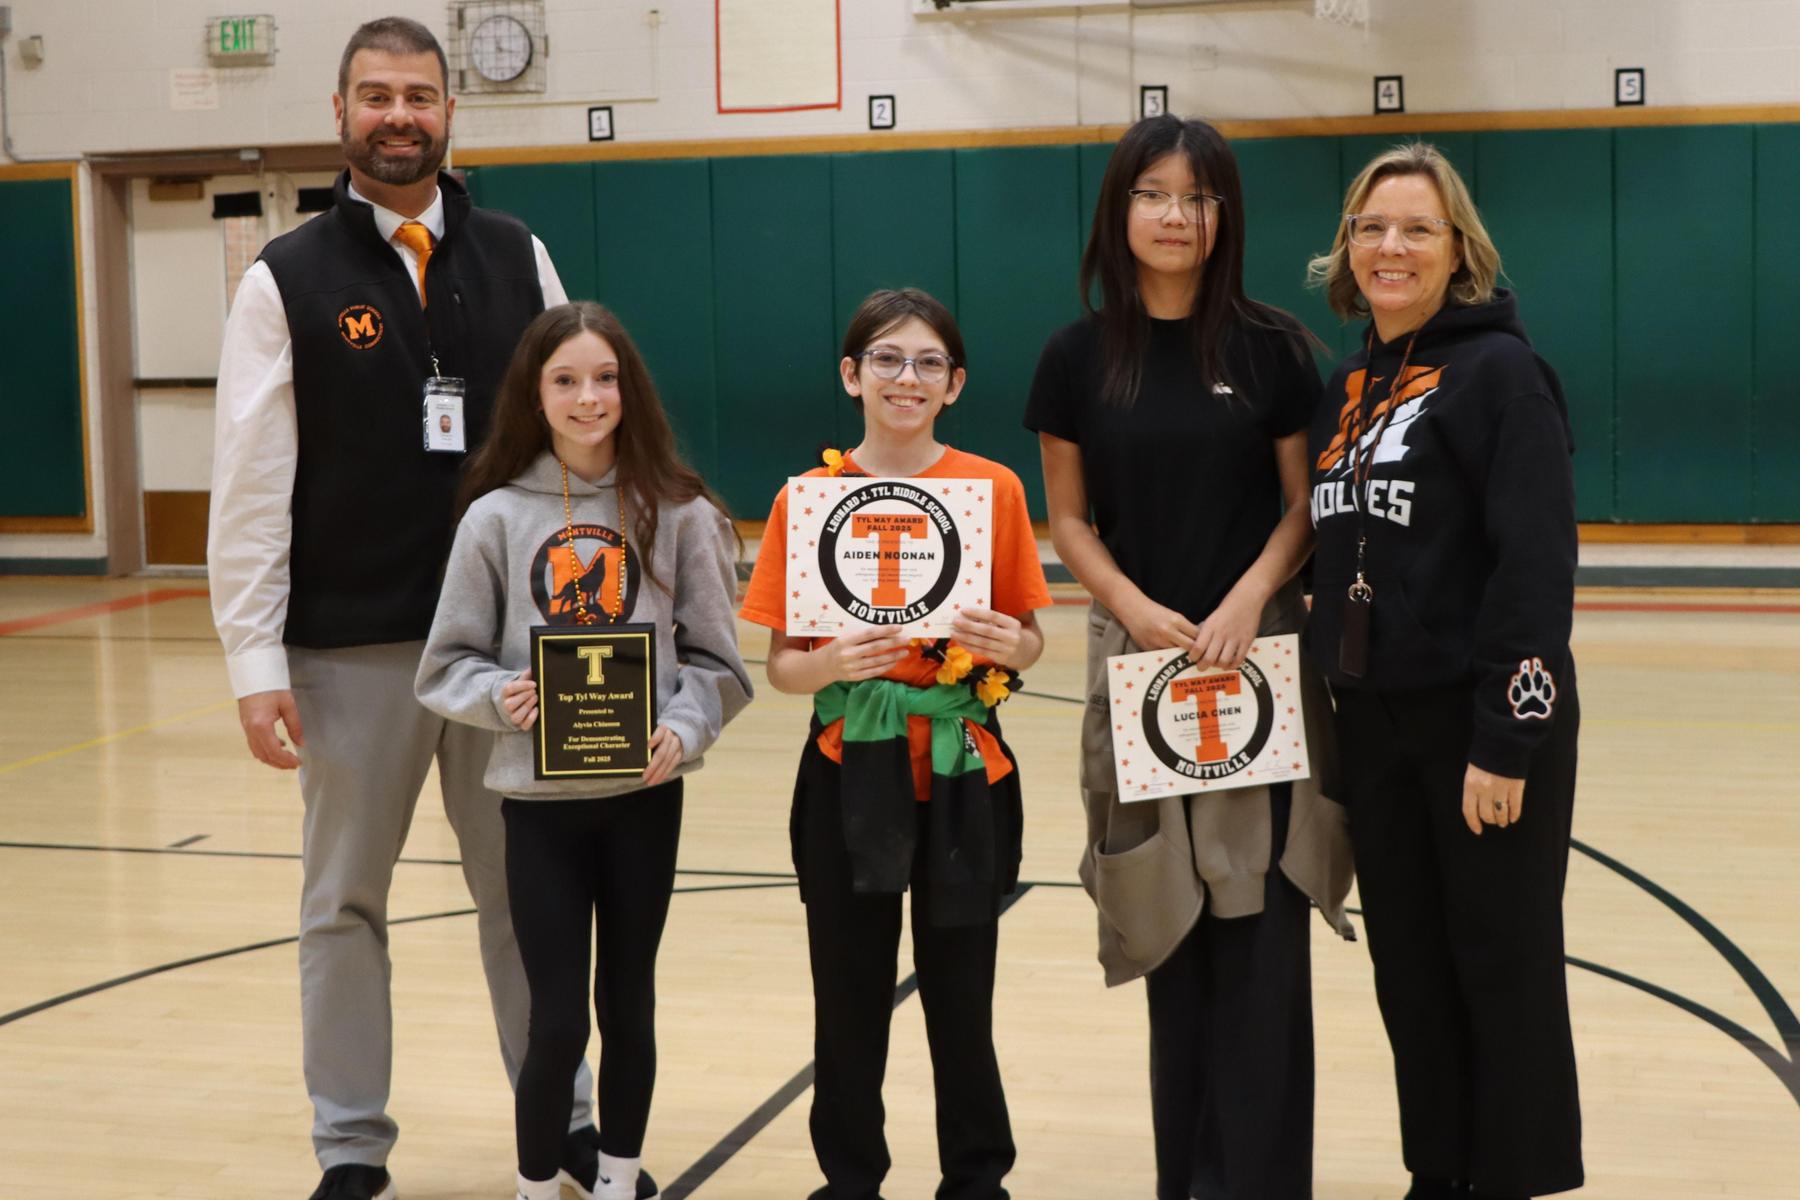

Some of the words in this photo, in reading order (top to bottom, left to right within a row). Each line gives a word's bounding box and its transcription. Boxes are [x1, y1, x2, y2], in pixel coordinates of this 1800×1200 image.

[221, 18, 256, 52] EXIT
[1382, 84, 1394, 104] 4
[1625, 77, 1637, 97] 5
[877, 103, 887, 120] 2
[1147, 96, 1160, 114] 3
[345, 312, 376, 340] M
[826, 496, 860, 533] LEONARD
[860, 492, 871, 501] J.
[871, 486, 891, 497] TYL
[892, 486, 928, 506] MIDDLE
[925, 501, 953, 534] SCHOOL
[843, 551, 880, 559] AIDEN
[884, 551, 935, 560] NOONAN
[847, 599, 930, 624] MONTVILLE
[577, 645, 614, 685] T
[1241, 662, 1263, 688] CHOOL
[1147, 664, 1178, 701] LEONARD
[558, 693, 574, 703] Top
[575, 692, 588, 702] Tyl
[589, 692, 607, 702] Way
[608, 691, 634, 700] Award
[1174, 711, 1208, 722] LUCIA
[1211, 706, 1242, 717] CHEN
[1174, 751, 1252, 778] MONTVILLE
